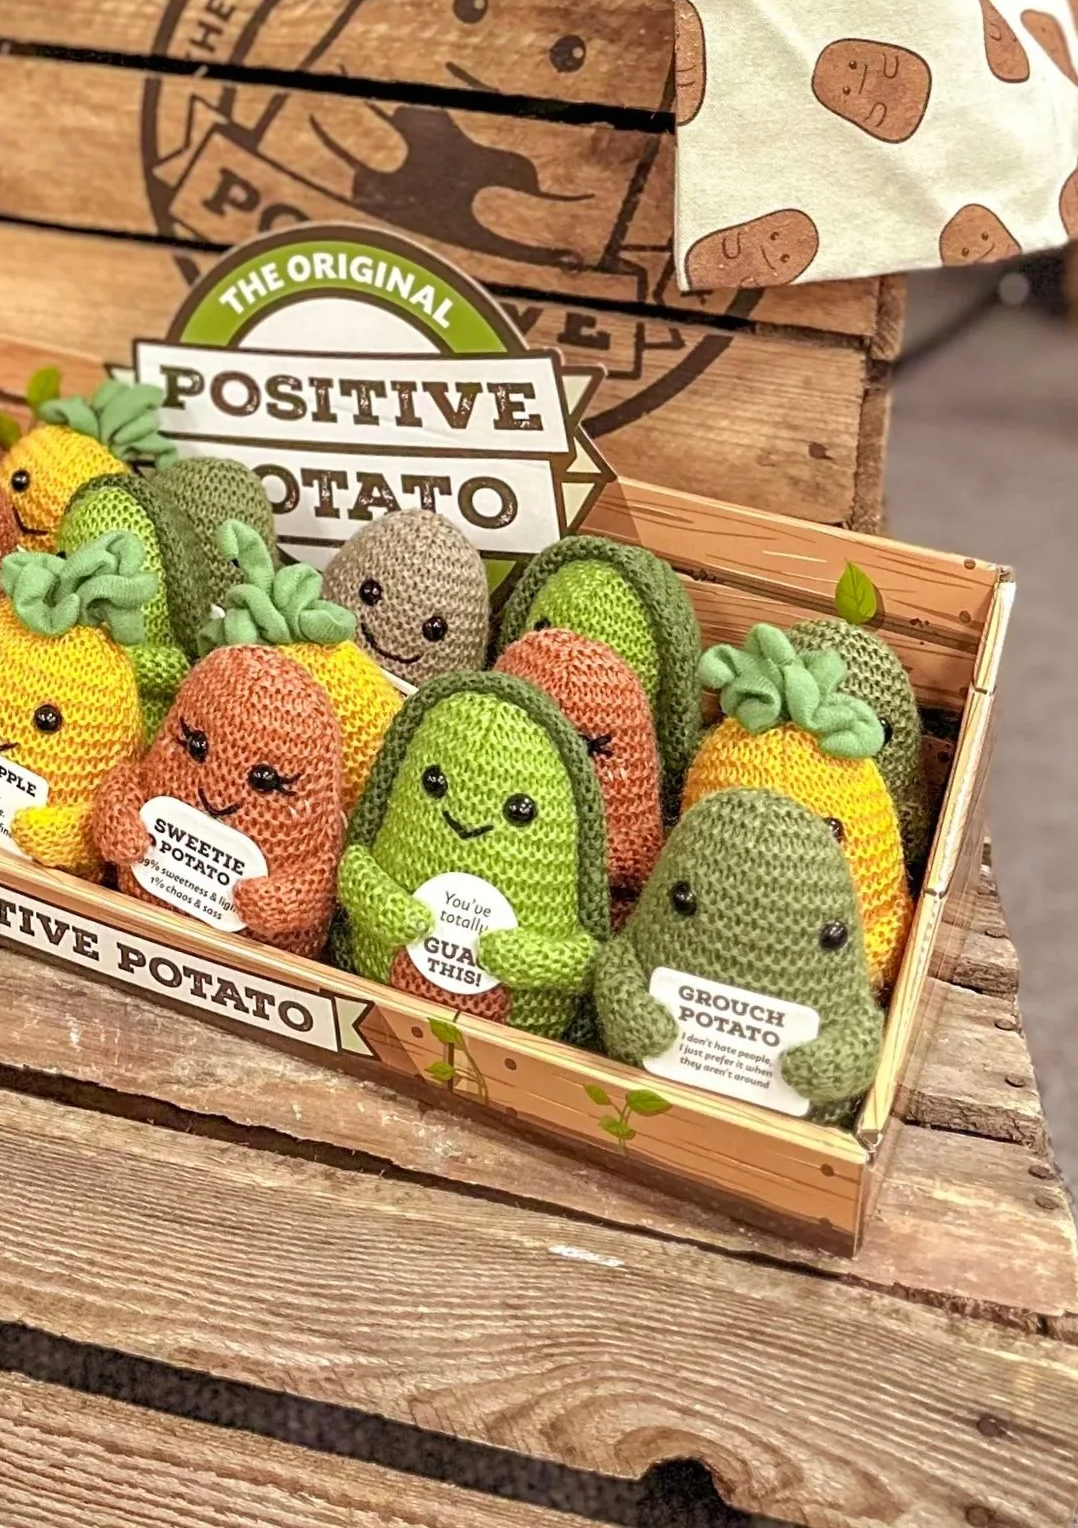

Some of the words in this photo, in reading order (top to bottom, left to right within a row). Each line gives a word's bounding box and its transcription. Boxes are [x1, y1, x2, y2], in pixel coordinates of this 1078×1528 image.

[218, 262, 286, 316] THE
[287, 252, 455, 329] ORIGINAL
[159, 365, 544, 431] POSITIVE
[251, 463, 519, 530] OTATO
[154, 818, 245, 876] SWEETIE
[160, 840, 230, 886] POTATO
[151, 877, 164, 889] 1%
[166, 885, 193, 904] chaos
[193, 899, 202, 909] &
[203, 905, 222, 920] sass
[162, 868, 208, 897] sweetness
[210, 893, 217, 902] &
[444, 891, 492, 918] You've
[423, 936, 476, 968] GUA
[427, 957, 482, 988] THIS!
[117, 941, 314, 1032] POTATO
[678, 985, 786, 1028] GROUCH
[678, 1005, 781, 1048] POTATO
[687, 1034, 713, 1048] don't
[714, 1041, 737, 1055] hate
[680, 1056, 702, 1071] they
[703, 1064, 733, 1078] aren't
[733, 1074, 771, 1089] around
[684, 1045, 703, 1057] just
[704, 1052, 735, 1066] prefer
[735, 1060, 744, 1069] it
[745, 1064, 773, 1078] when
